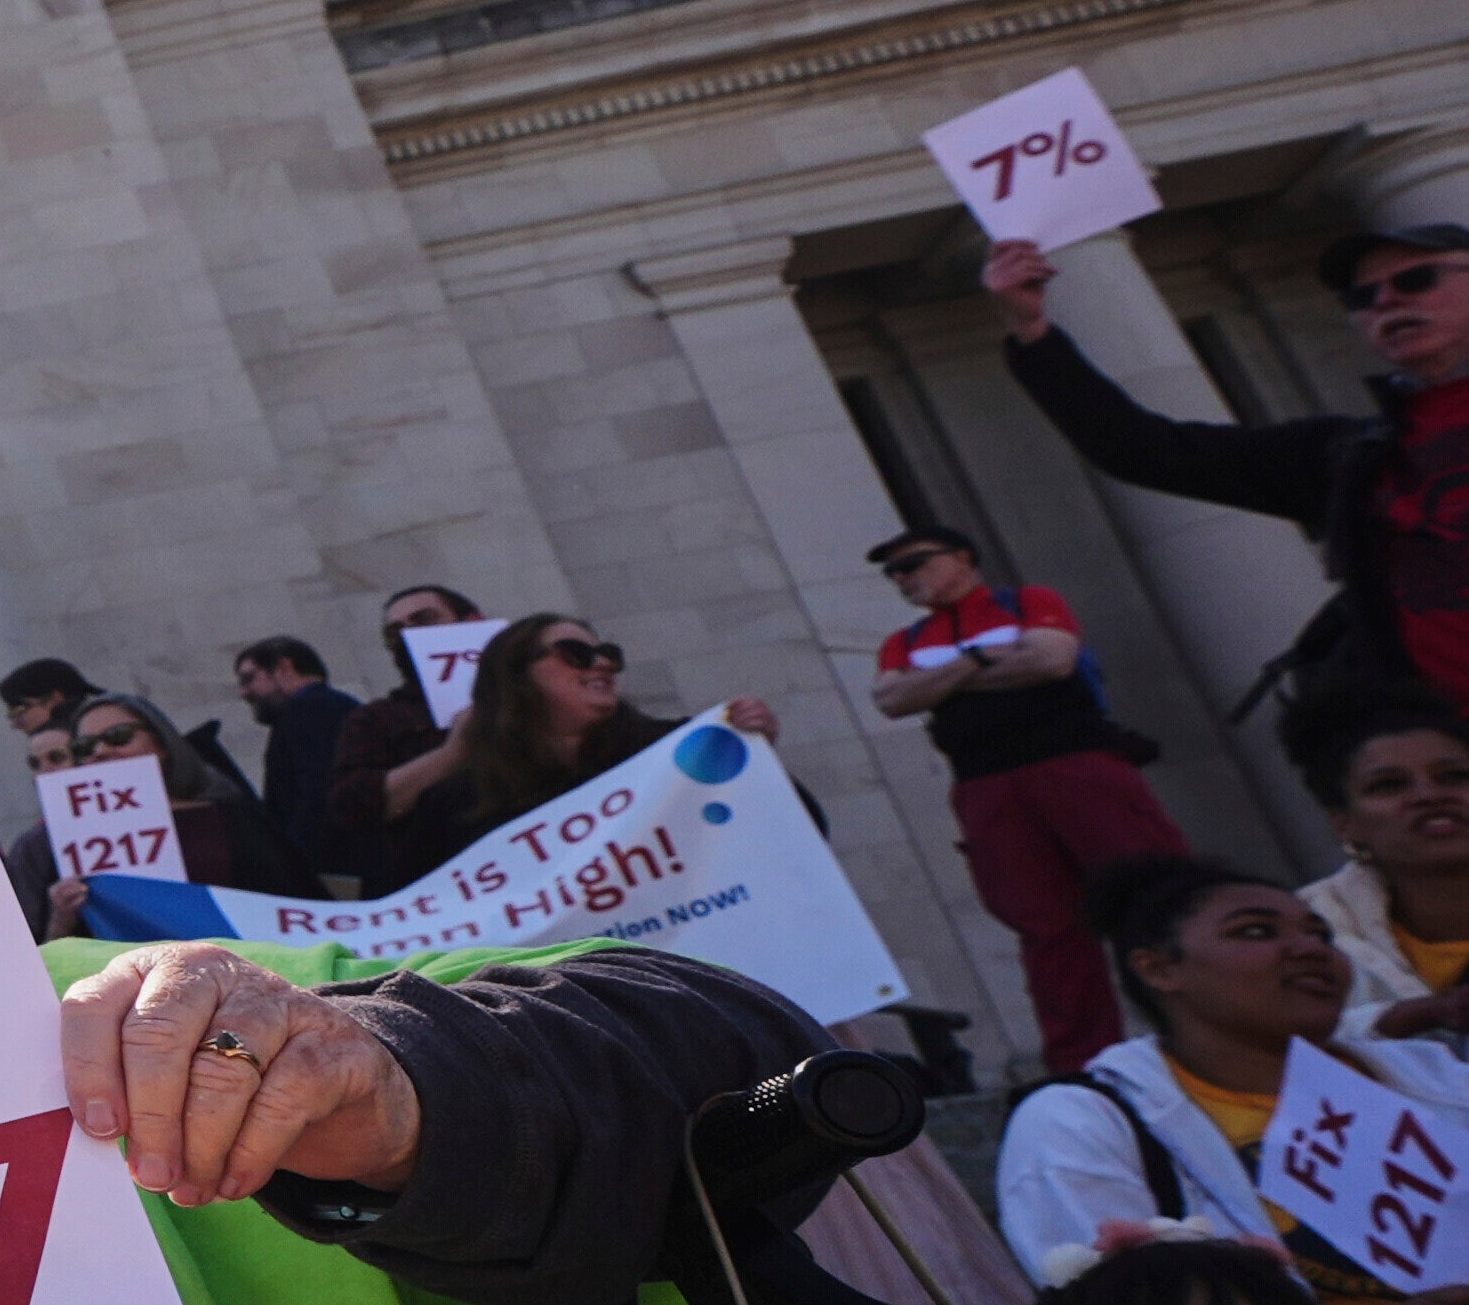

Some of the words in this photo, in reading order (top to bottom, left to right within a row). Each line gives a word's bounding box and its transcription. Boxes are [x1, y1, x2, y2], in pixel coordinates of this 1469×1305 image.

[969, 118, 1108, 202] 7%
[67, 781, 142, 819] Fix
[61, 826, 168, 874] 1217
[276, 892, 444, 935] Rent
[451, 859, 510, 903] is
[508, 786, 636, 865] Too
[504, 824, 687, 930] High!
[665, 883, 752, 925] NOW!
[1282, 1097, 1356, 1204] Fix
[1365, 1106, 1457, 1279] 1217
